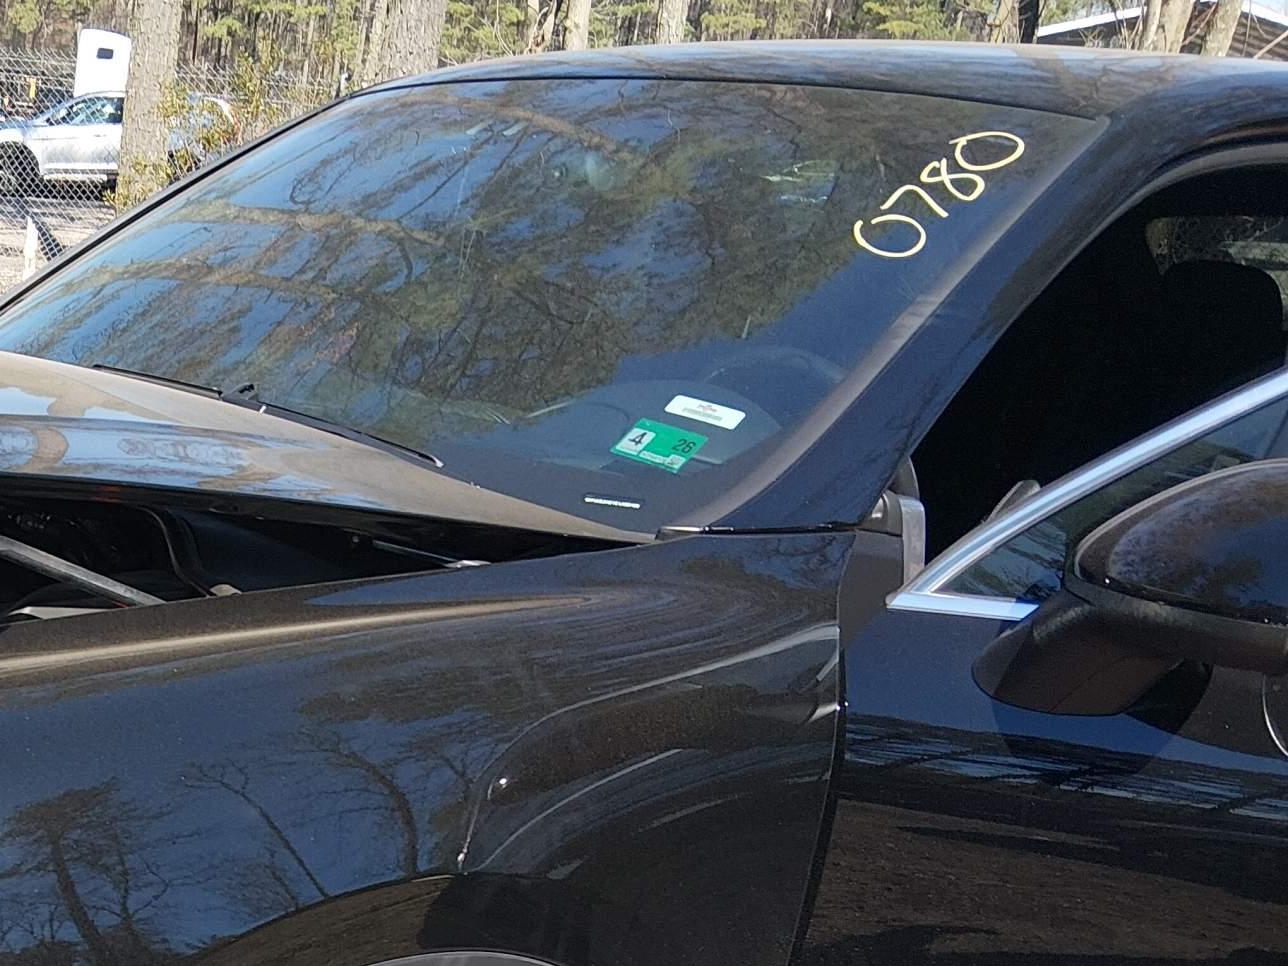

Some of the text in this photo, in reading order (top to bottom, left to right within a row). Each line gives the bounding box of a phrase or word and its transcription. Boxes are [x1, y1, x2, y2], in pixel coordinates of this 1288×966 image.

[853, 131, 1025, 258] 0780
[627, 431, 696, 454] 4 26
